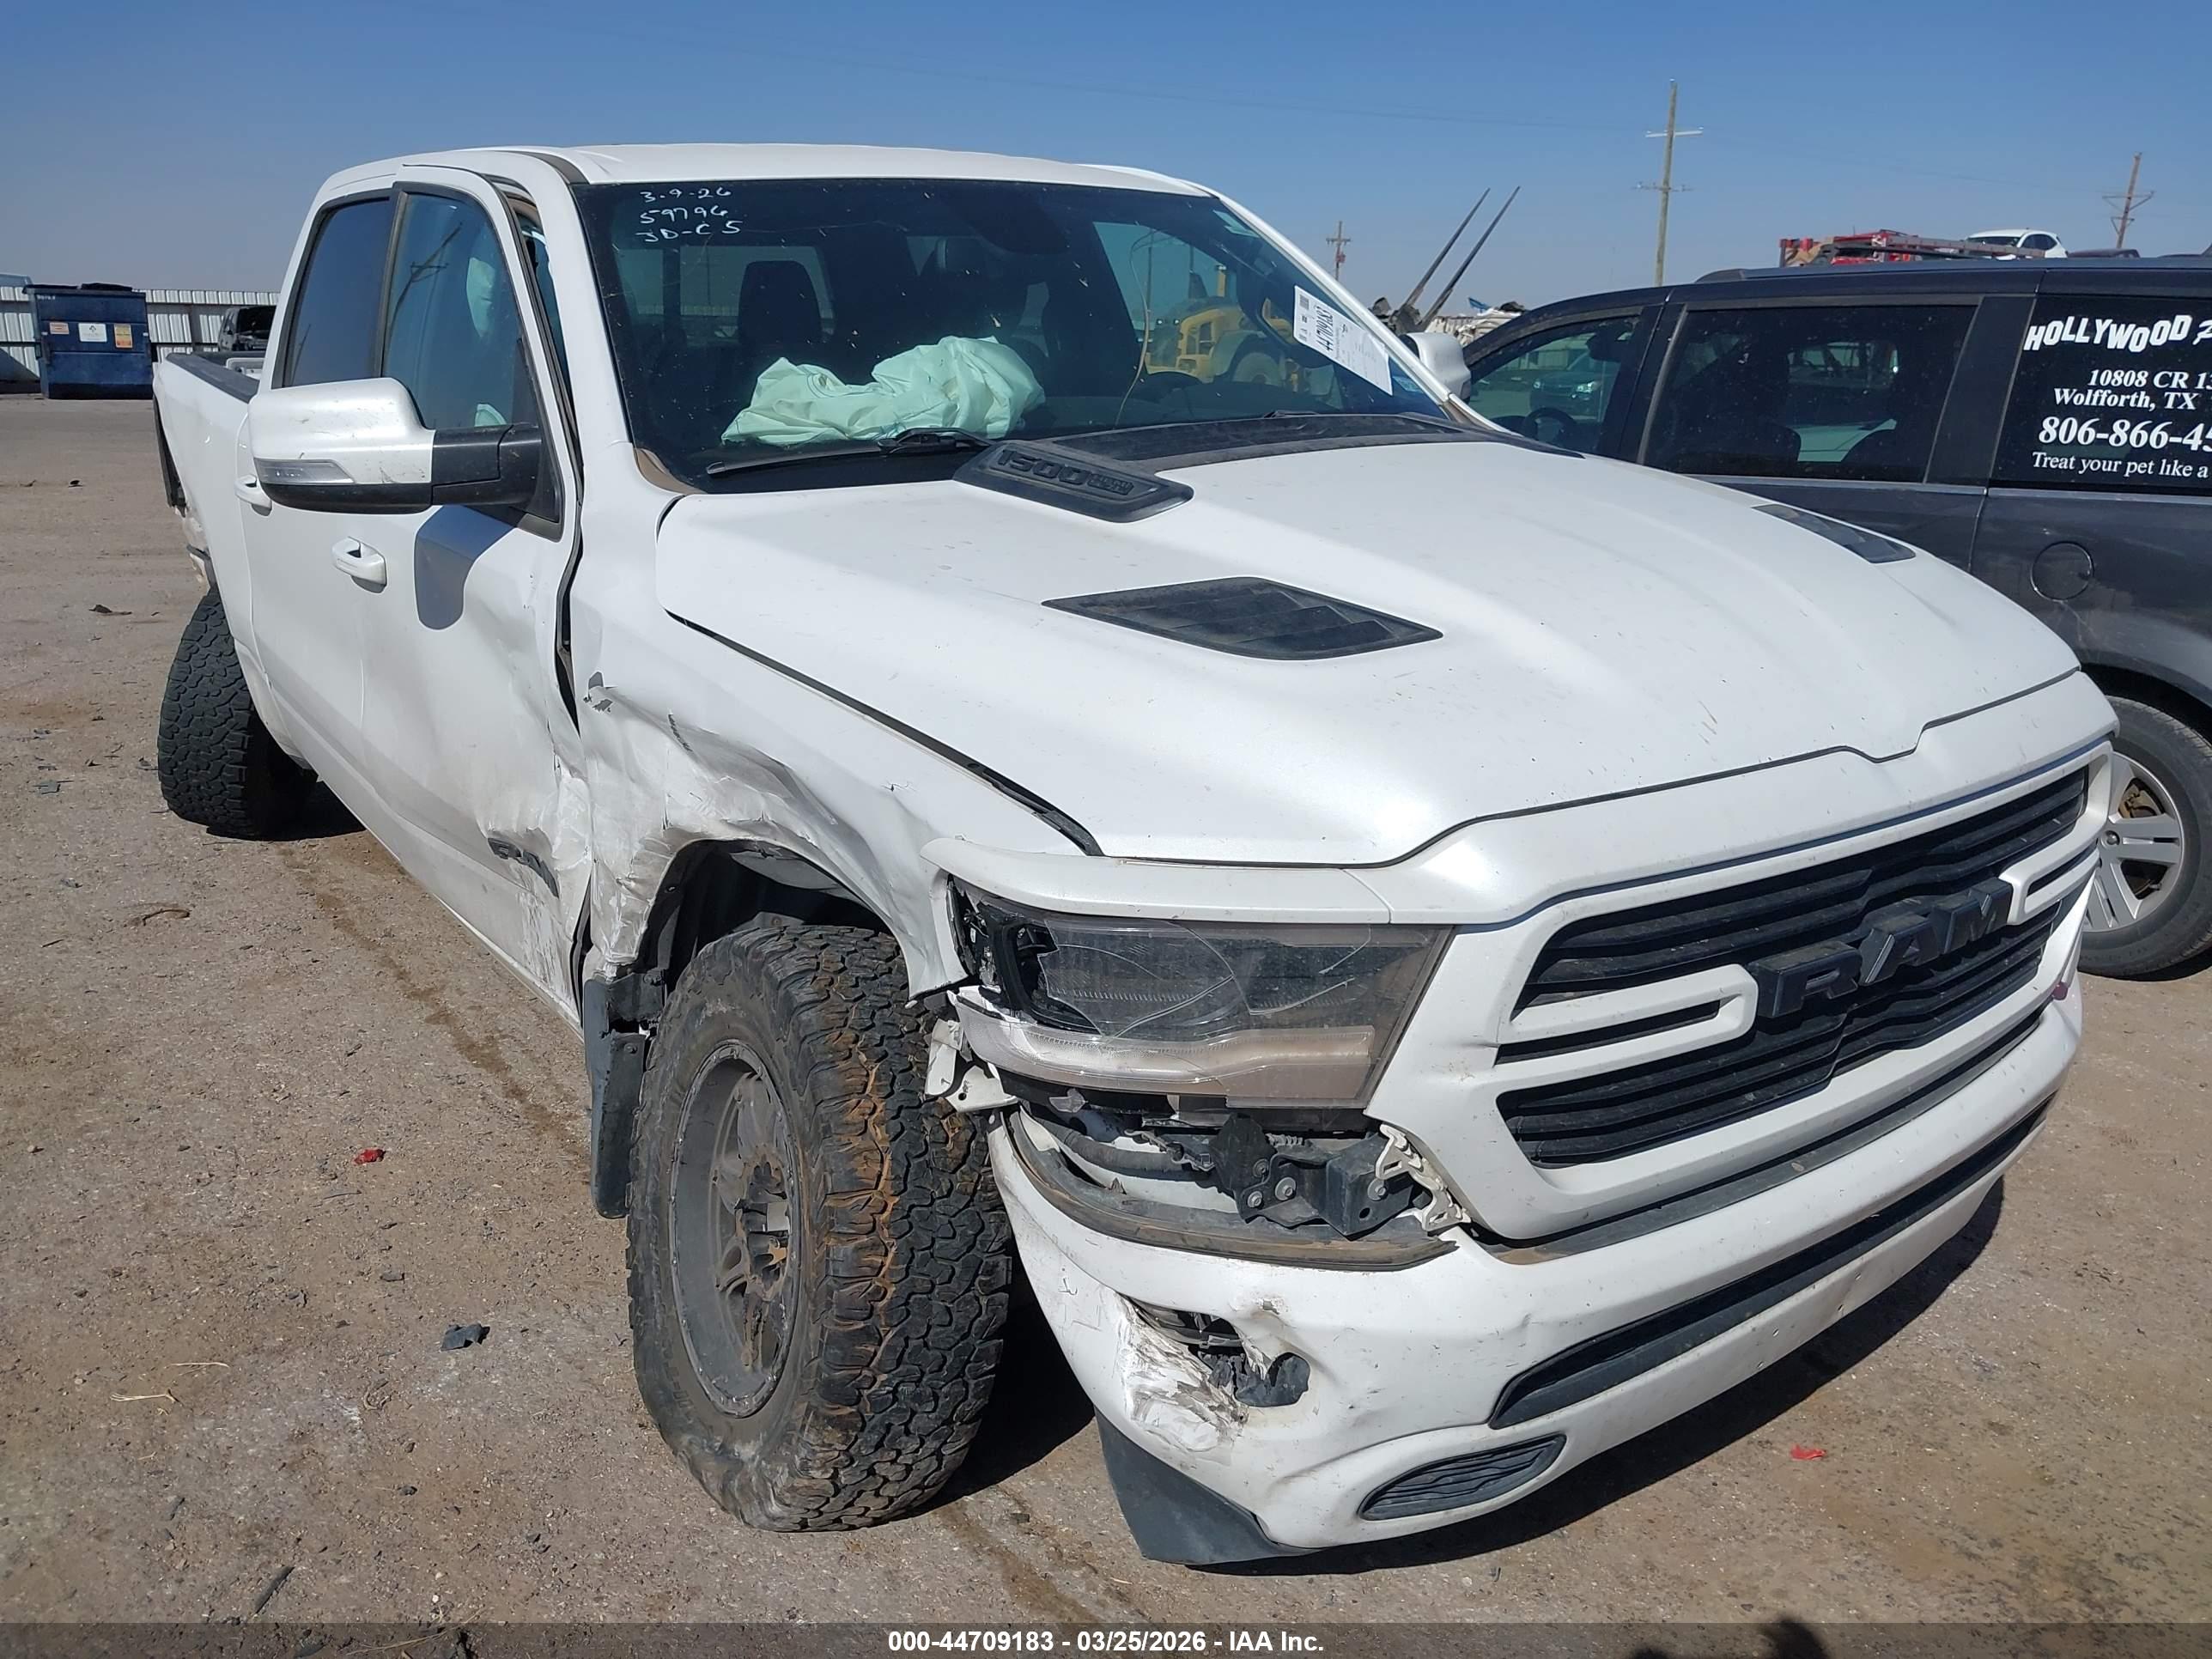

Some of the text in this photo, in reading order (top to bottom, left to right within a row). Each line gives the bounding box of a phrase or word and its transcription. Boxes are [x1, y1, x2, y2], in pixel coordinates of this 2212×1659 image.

[2023, 315, 2192, 354] HOLLYWOOD
[2087, 369, 2148, 387] 10808
[2153, 371, 2190, 389] CR
[2054, 387, 2199, 412] Wolfforth, TX
[997, 449, 1092, 486] 1500
[2032, 452, 2209, 478] Treat your pet like a
[1758, 877, 2014, 1018] RAM
